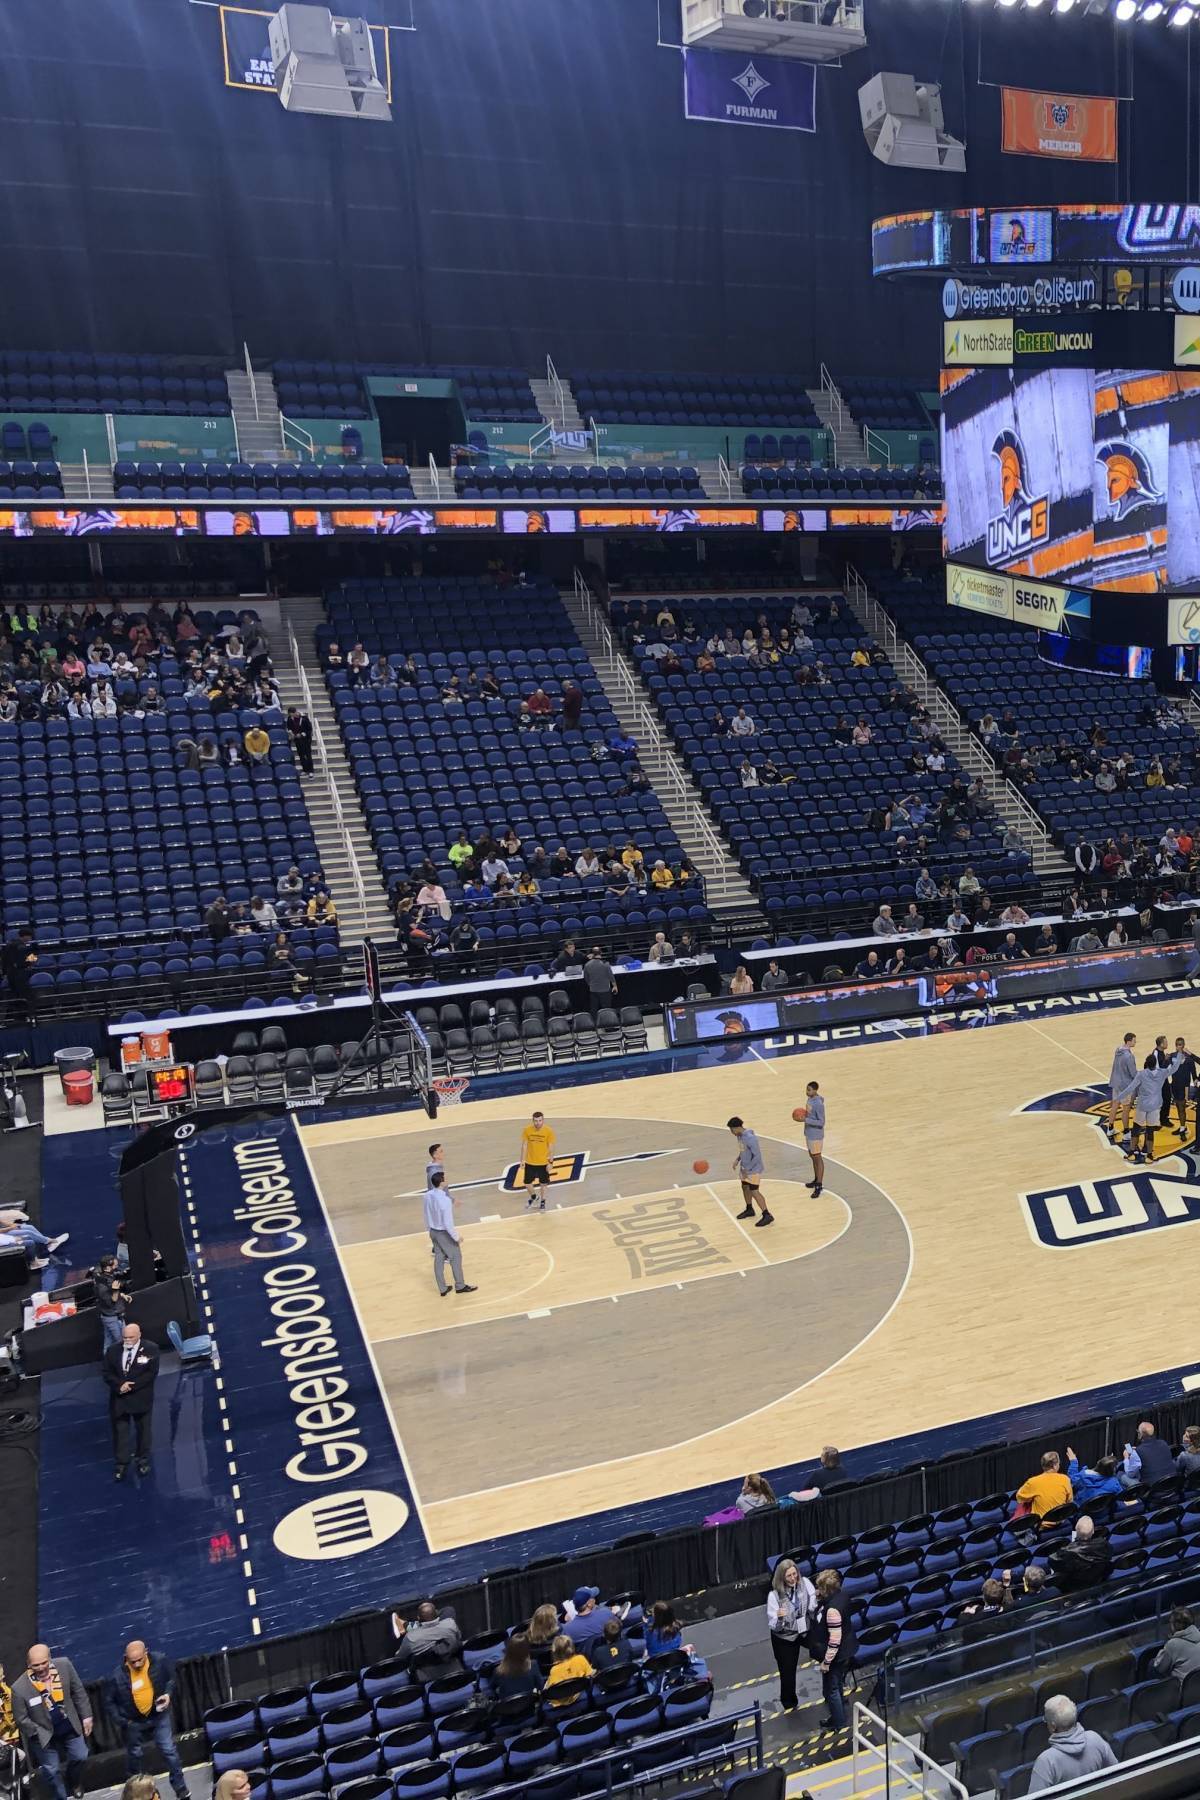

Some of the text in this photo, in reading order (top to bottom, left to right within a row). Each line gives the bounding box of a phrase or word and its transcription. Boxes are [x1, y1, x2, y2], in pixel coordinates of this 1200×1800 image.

[726, 104, 778, 120] FURMAN
[1039, 139, 1081, 153] MERCER
[961, 284, 1029, 310] Greensboro
[1033, 277, 1095, 305] Coliseum
[963, 333, 1012, 352] NorthState
[1015, 328, 1093, 354] GREEN LINCOLN
[203, 421, 217, 429] 213
[988, 499, 1049, 562] UNCG
[1016, 589, 1058, 613] SEGRA
[158, 1082, 184, 1100] 30
[286, 1097, 325, 1110] SPALDING
[233, 1137, 368, 1482] Greensboro Coliseum
